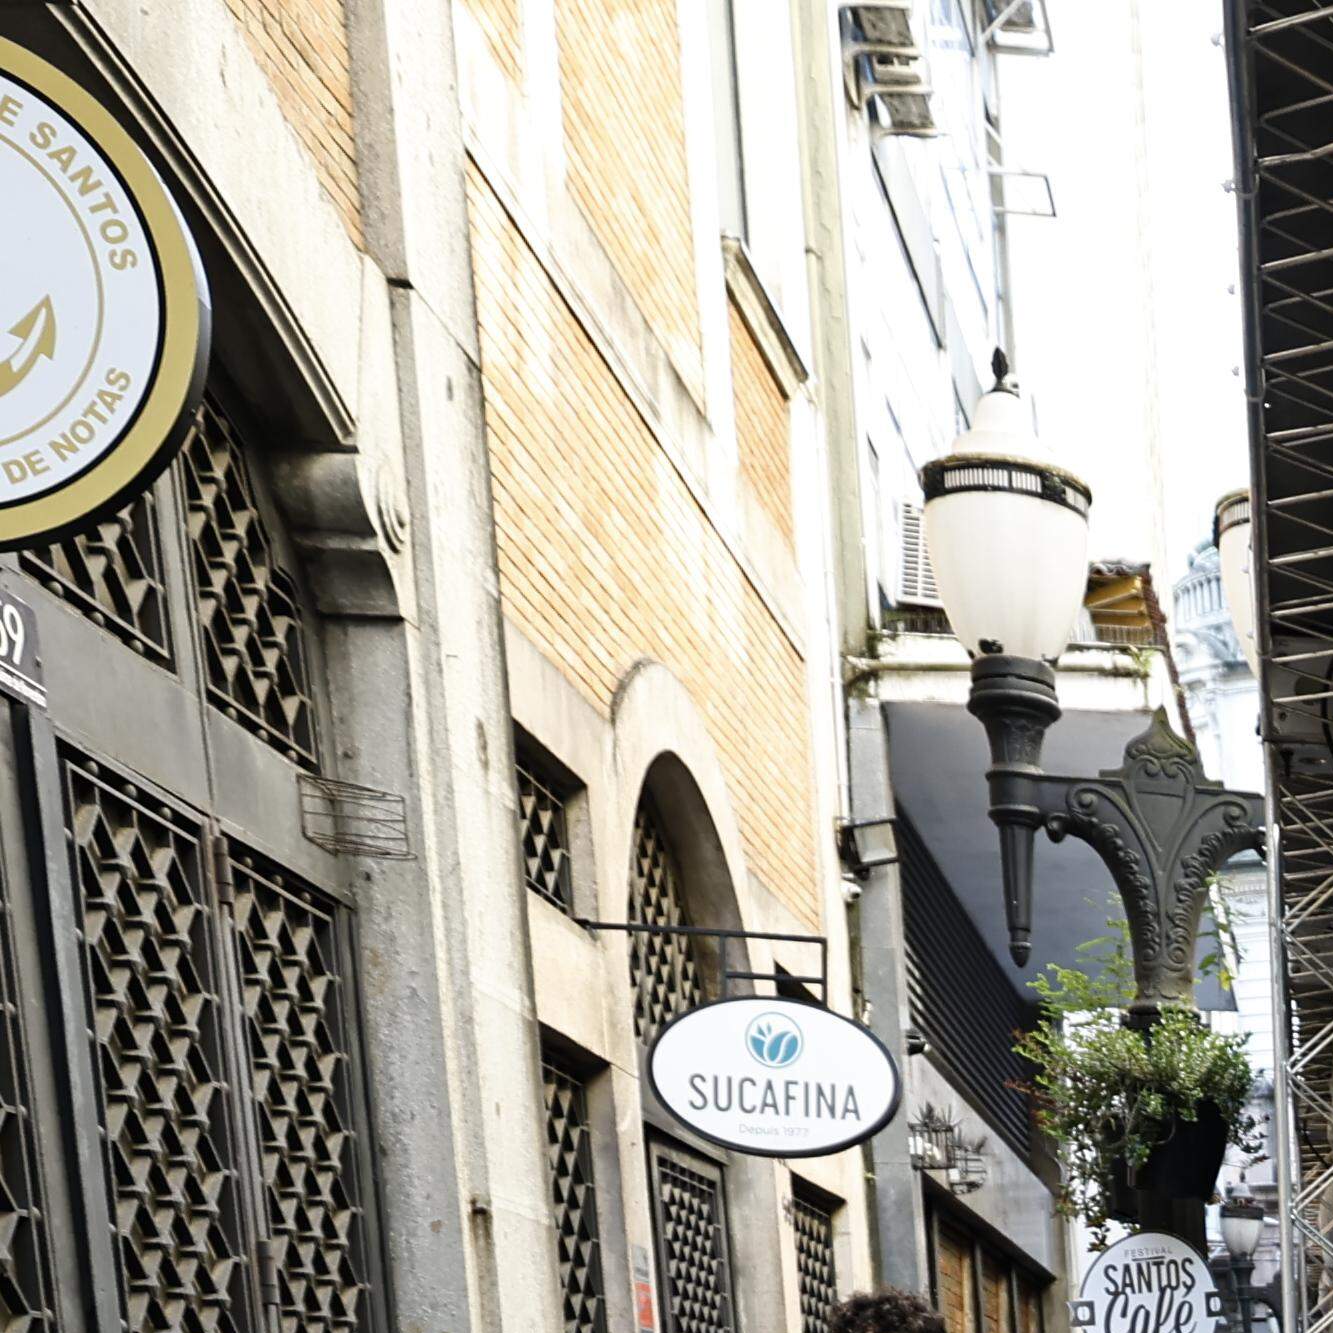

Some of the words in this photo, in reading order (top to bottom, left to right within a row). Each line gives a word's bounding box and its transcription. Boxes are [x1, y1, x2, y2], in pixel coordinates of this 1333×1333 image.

[29, 121, 138, 271] SANTOS
[1, 449, 51, 485] DE
[48, 367, 131, 463] NOTAS
[688, 1073, 861, 1121] SUCAFINA
[738, 1123, 779, 1136] Depuis
[1124, 1246, 1173, 1258] FESTIVAL
[1104, 1257, 1196, 1296] SANTOS
